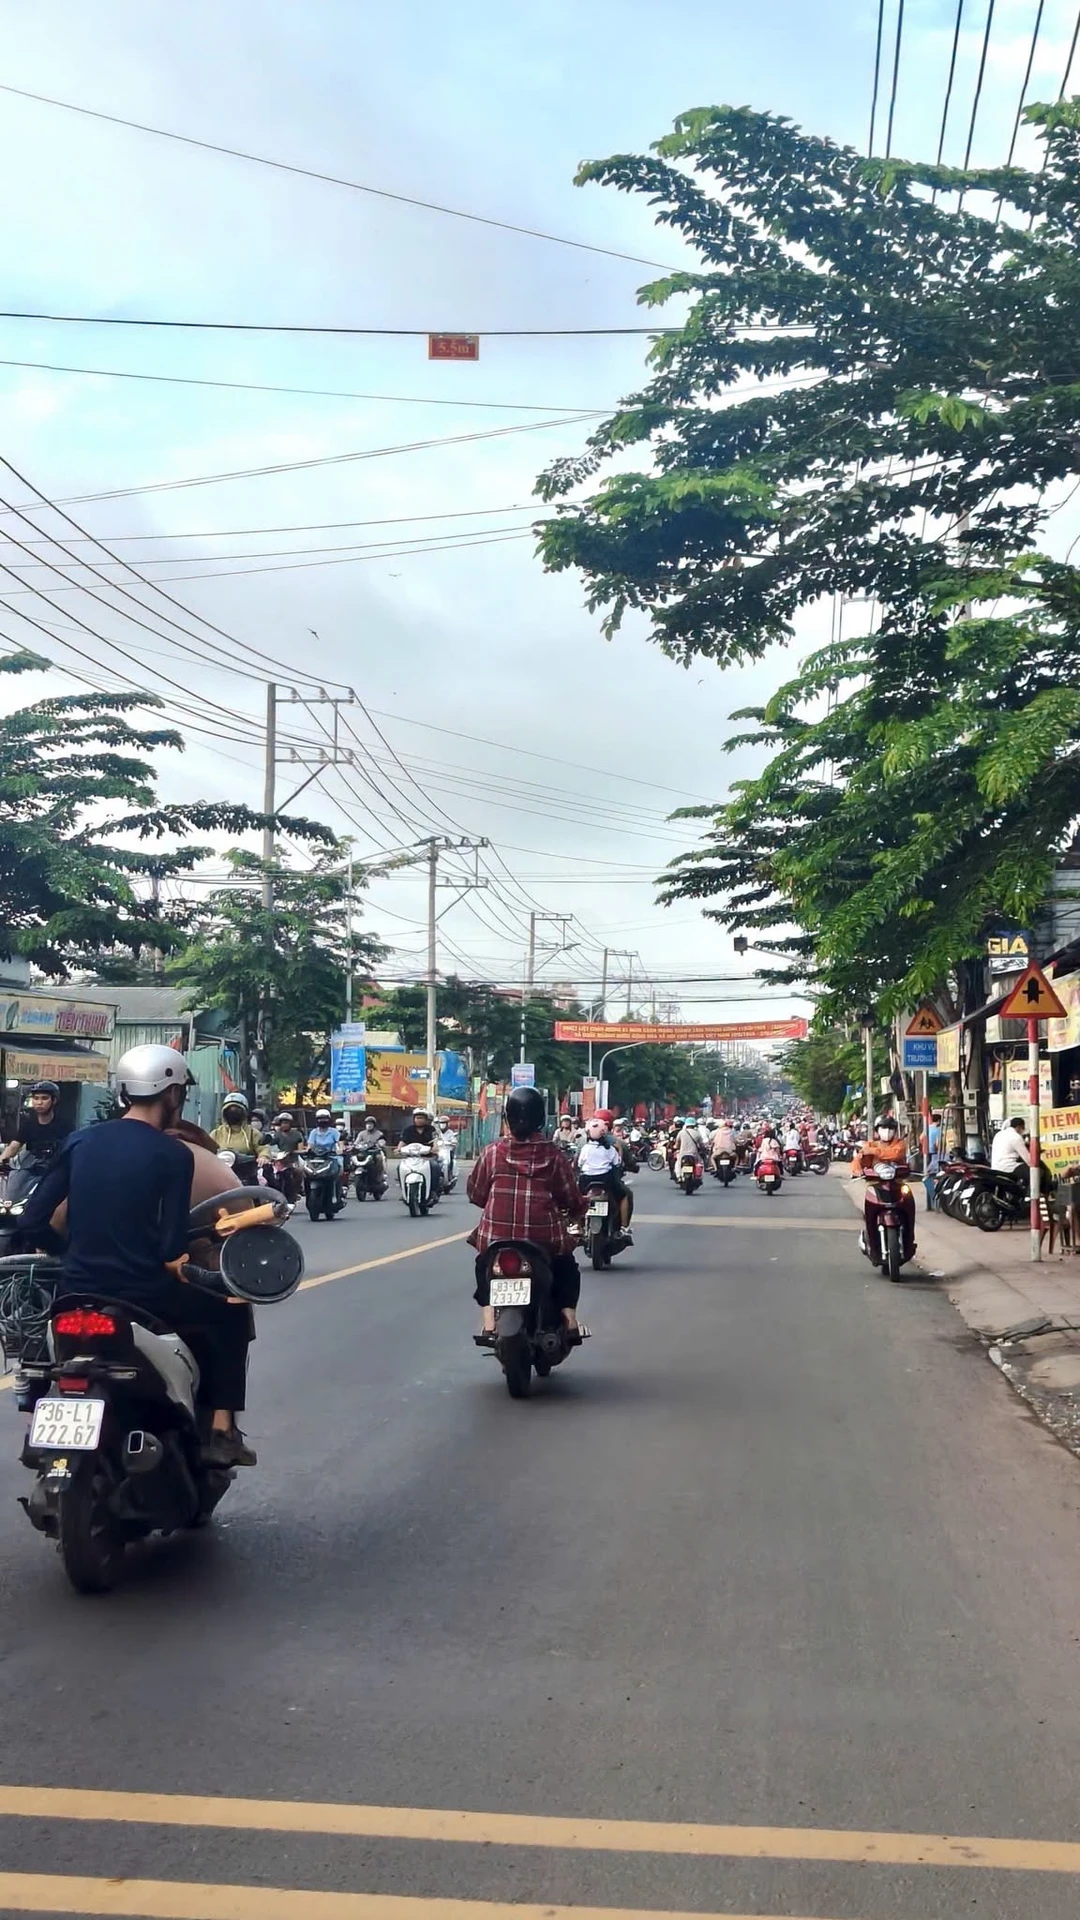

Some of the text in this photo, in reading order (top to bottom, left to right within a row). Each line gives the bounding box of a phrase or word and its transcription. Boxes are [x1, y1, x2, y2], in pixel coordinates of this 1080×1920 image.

[913, 1042, 927, 1051] KHU
[45, 1403, 92, 1423] 36-L1
[35, 1424, 96, 1446] 222.67
